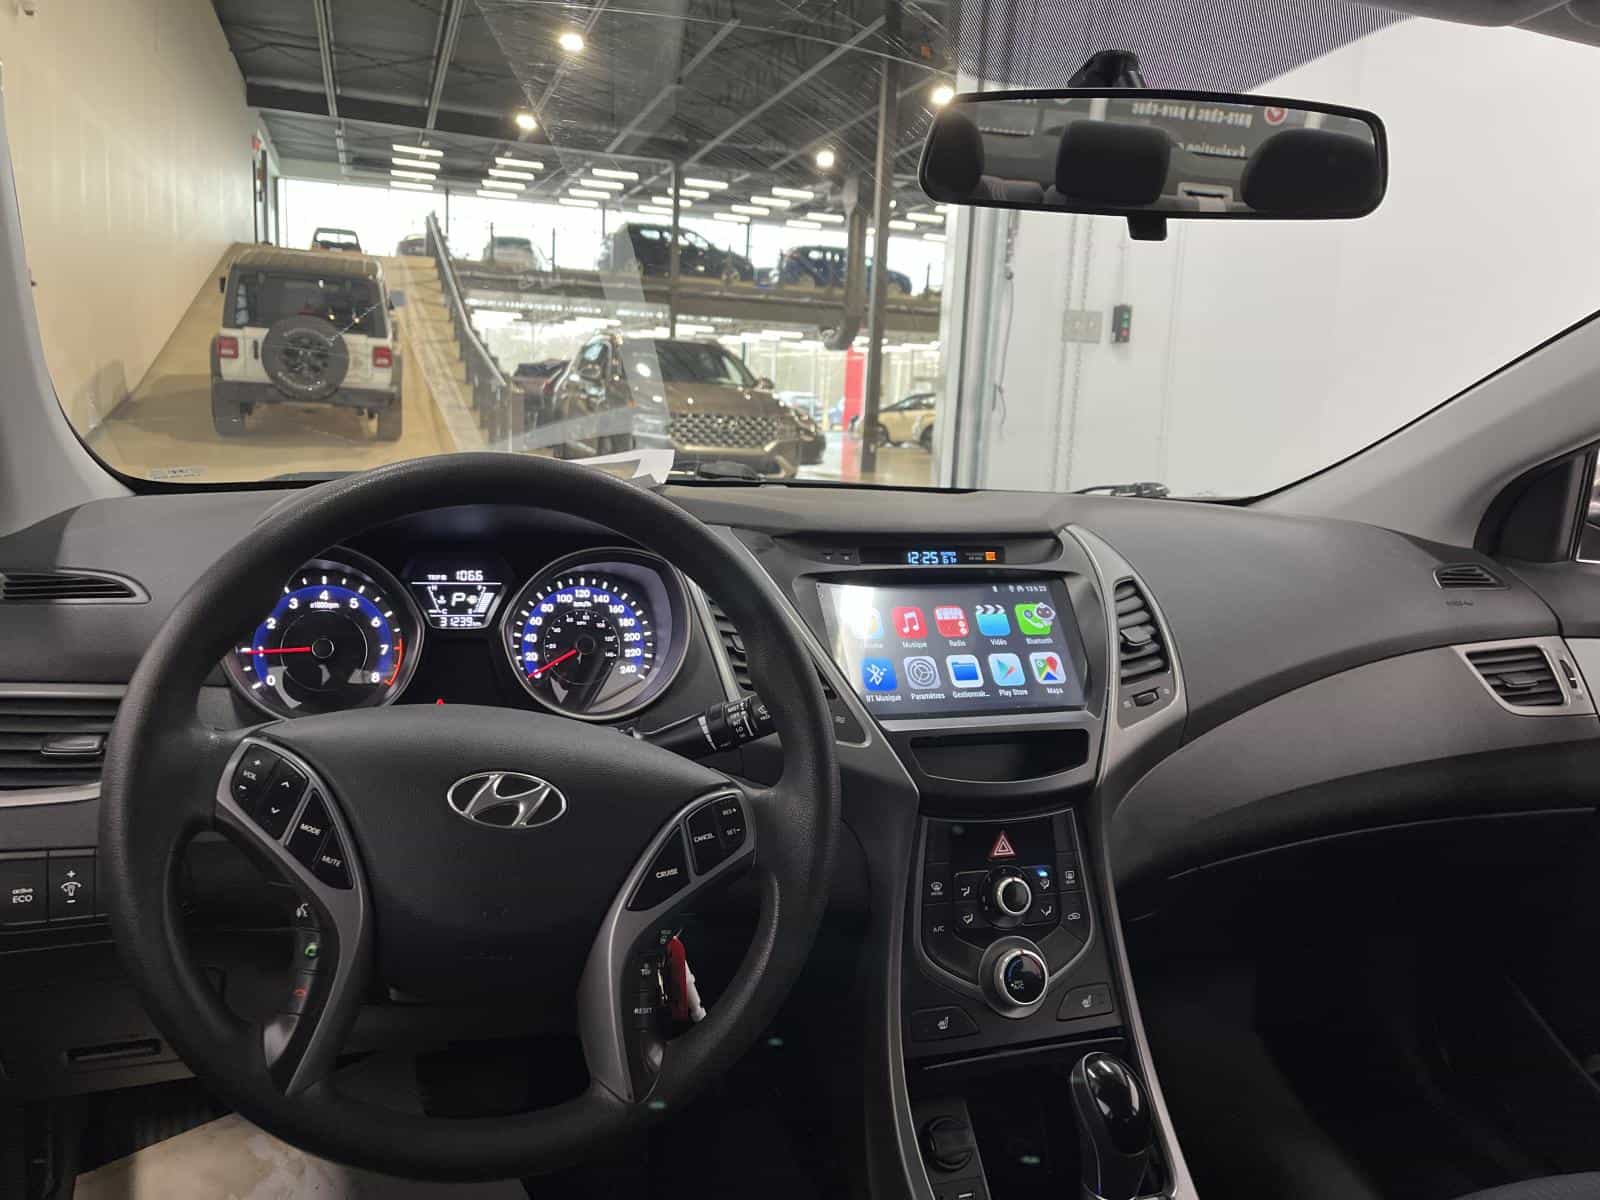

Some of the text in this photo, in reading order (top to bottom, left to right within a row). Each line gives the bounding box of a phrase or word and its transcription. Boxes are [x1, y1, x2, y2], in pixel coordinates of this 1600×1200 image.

[907, 551, 939, 564] 12:25
[320, 590, 329, 601] 4
[556, 594, 573, 602] 100
[575, 589, 591, 598] 120
[593, 594, 610, 603] 140
[288, 598, 298, 609] 3
[349, 598, 359, 609] 5
[451, 592, 466, 607] P
[541, 603, 554, 612] 80
[608, 604, 625, 613] 160
[266, 618, 276, 629] 2
[371, 616, 381, 627] 6
[529, 617, 542, 626] 60
[618, 618, 635, 627] 180
[524, 633, 538, 643] 40
[623, 632, 641, 641] 200
[380, 644, 389, 655] 7
[624, 648, 642, 657] 220
[525, 652, 538, 662] 20
[619, 665, 637, 674] 240
[266, 674, 276, 686] 0
[370, 671, 380, 683] 8
[1047, 687, 1064, 695] Maps
[300, 823, 320, 836] MODE
[694, 832, 715, 842] CANCEL
[321, 855, 341, 867] MUTE
[655, 868, 678, 879] CRUISE
[12, 894, 33, 904] ECO
